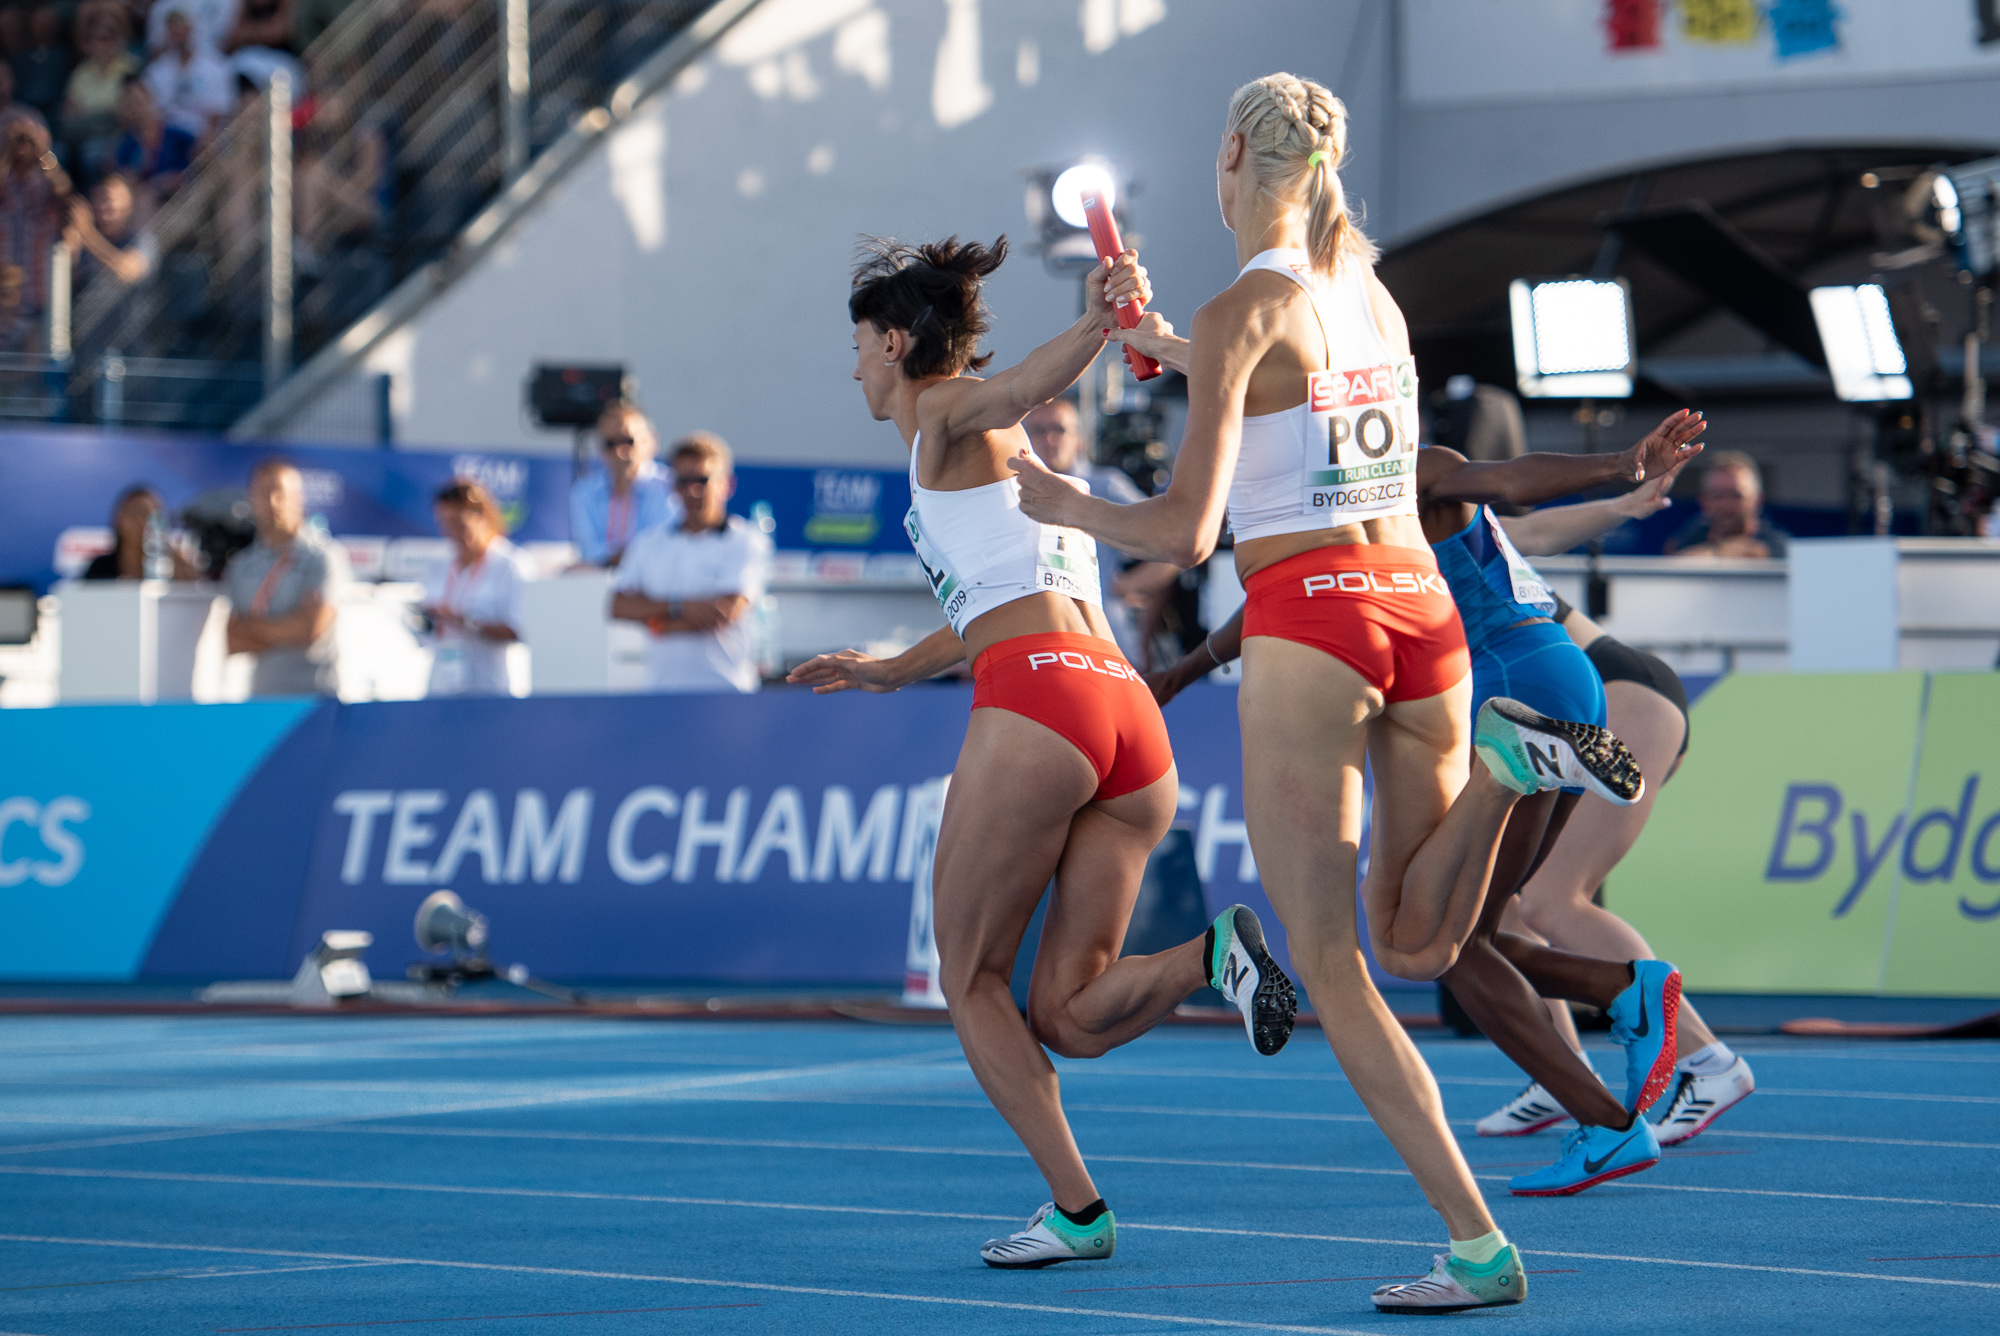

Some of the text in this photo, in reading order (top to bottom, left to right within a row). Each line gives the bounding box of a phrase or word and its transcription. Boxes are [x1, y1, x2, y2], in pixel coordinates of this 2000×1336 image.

[1314, 370, 1393, 407] SPAR
[1328, 405, 1414, 465] POL
[1344, 466, 1370, 482] RUN
[1370, 462, 1410, 478] CLEAN
[1313, 482, 1406, 507] BYDGOSZCZ
[947, 590, 967, 619] 2019
[333, 786, 597, 885] TEAM
